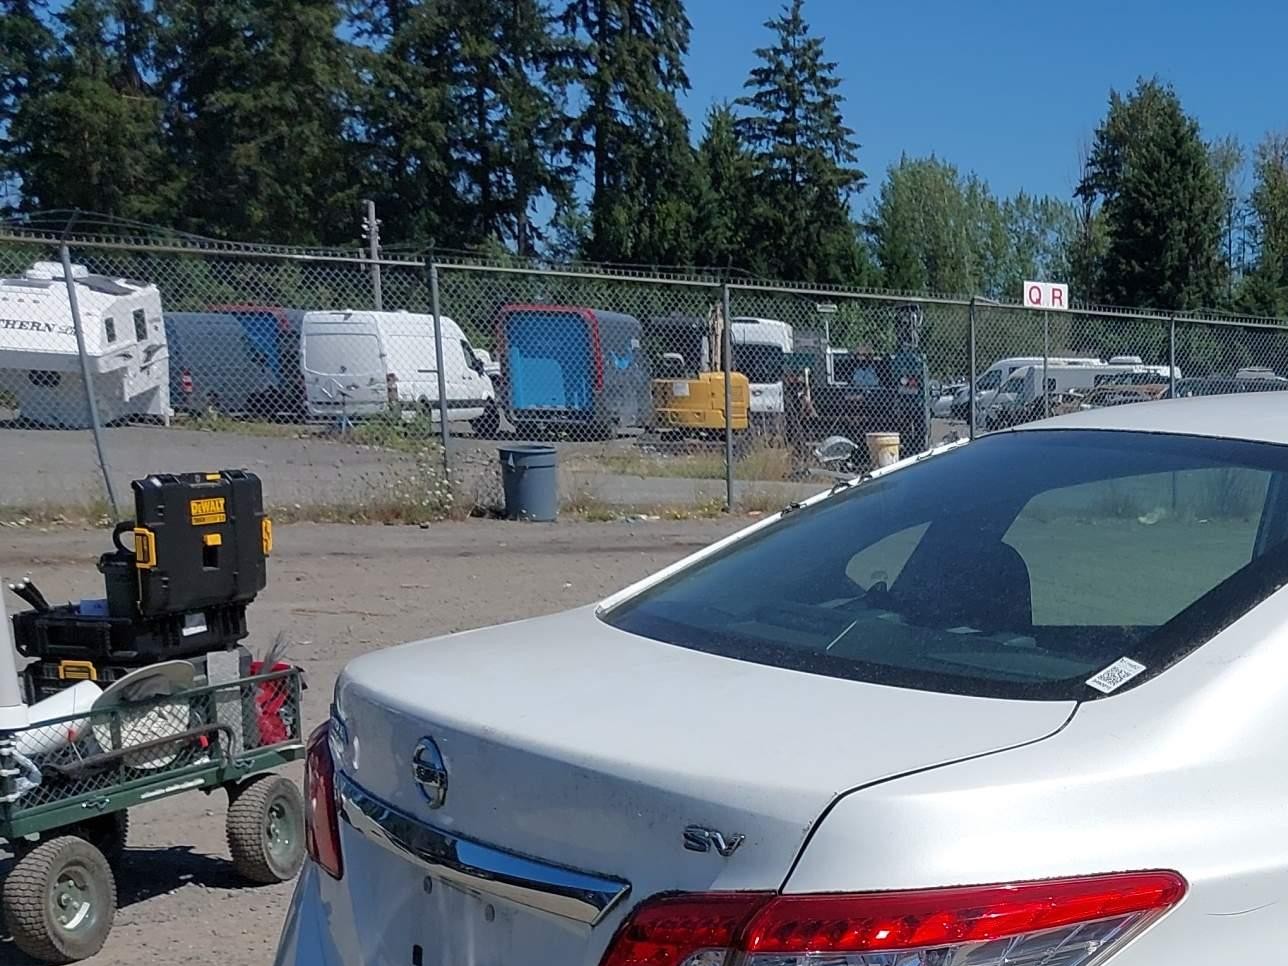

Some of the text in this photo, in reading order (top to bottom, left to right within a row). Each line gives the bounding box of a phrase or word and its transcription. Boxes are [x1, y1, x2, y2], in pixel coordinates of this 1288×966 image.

[1029, 286, 1062, 306] Q R
[683, 824, 745, 857] SV
